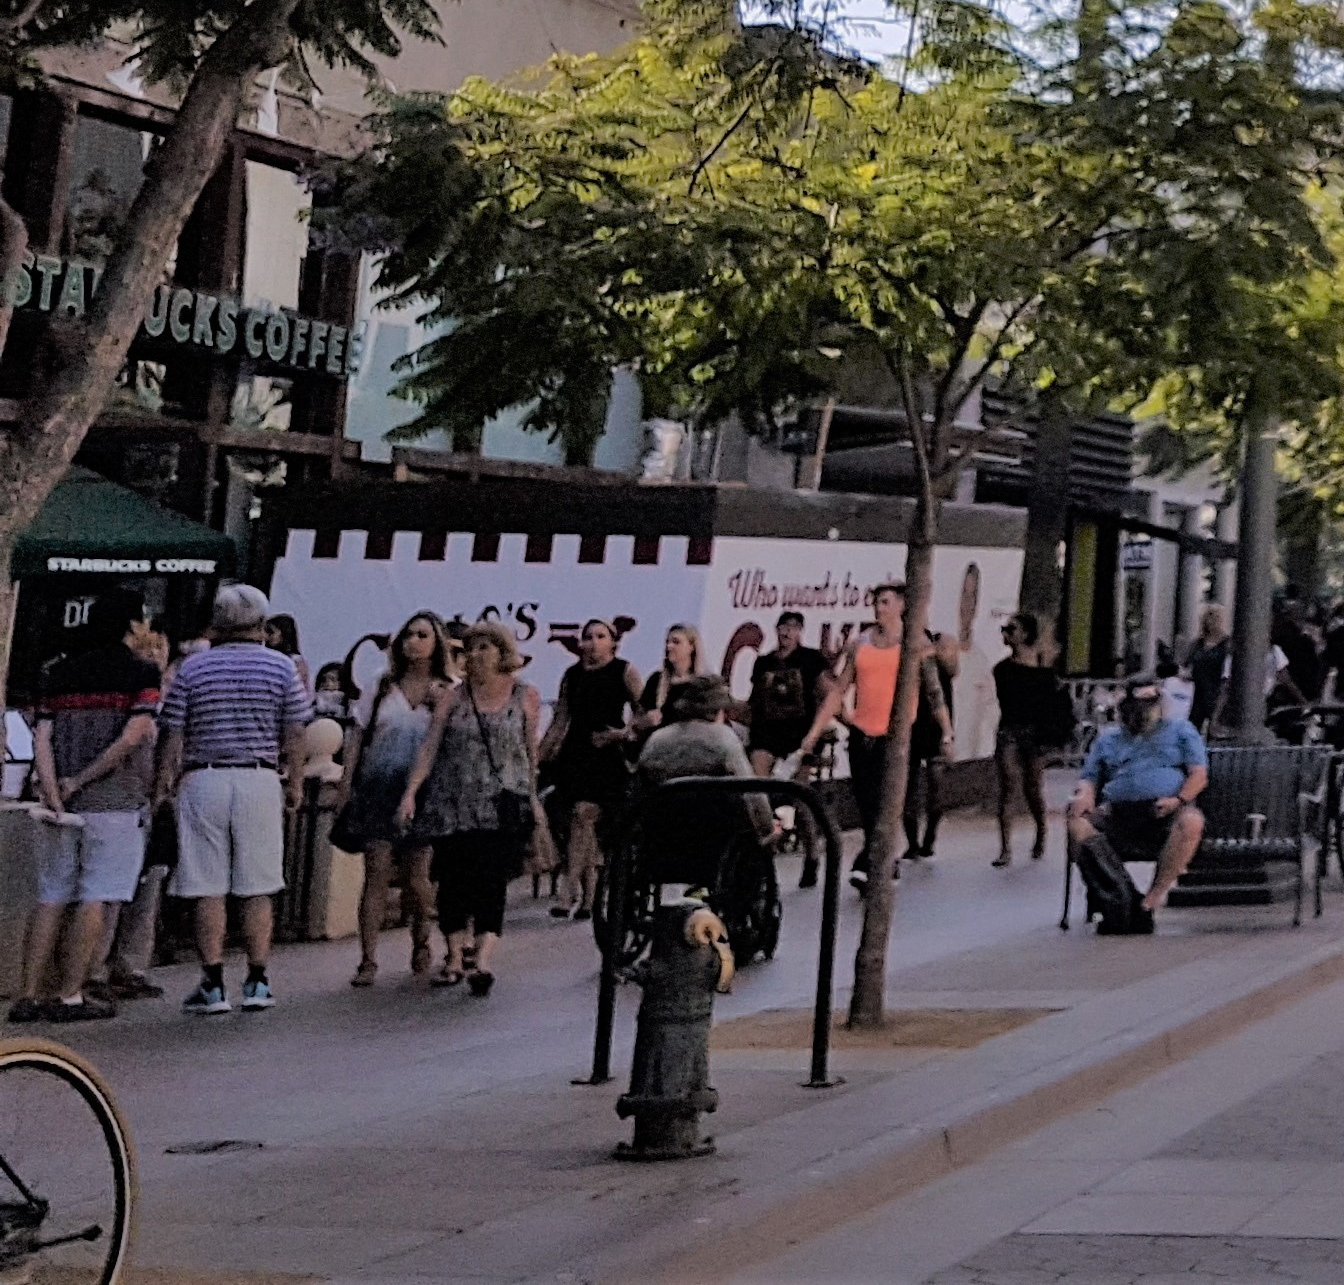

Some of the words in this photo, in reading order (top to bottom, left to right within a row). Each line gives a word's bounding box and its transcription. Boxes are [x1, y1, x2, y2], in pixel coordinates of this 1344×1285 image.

[11, 249, 238, 354] STAUCKS
[245, 312, 367, 375] COFFEE
[728, 567, 779, 608] Who
